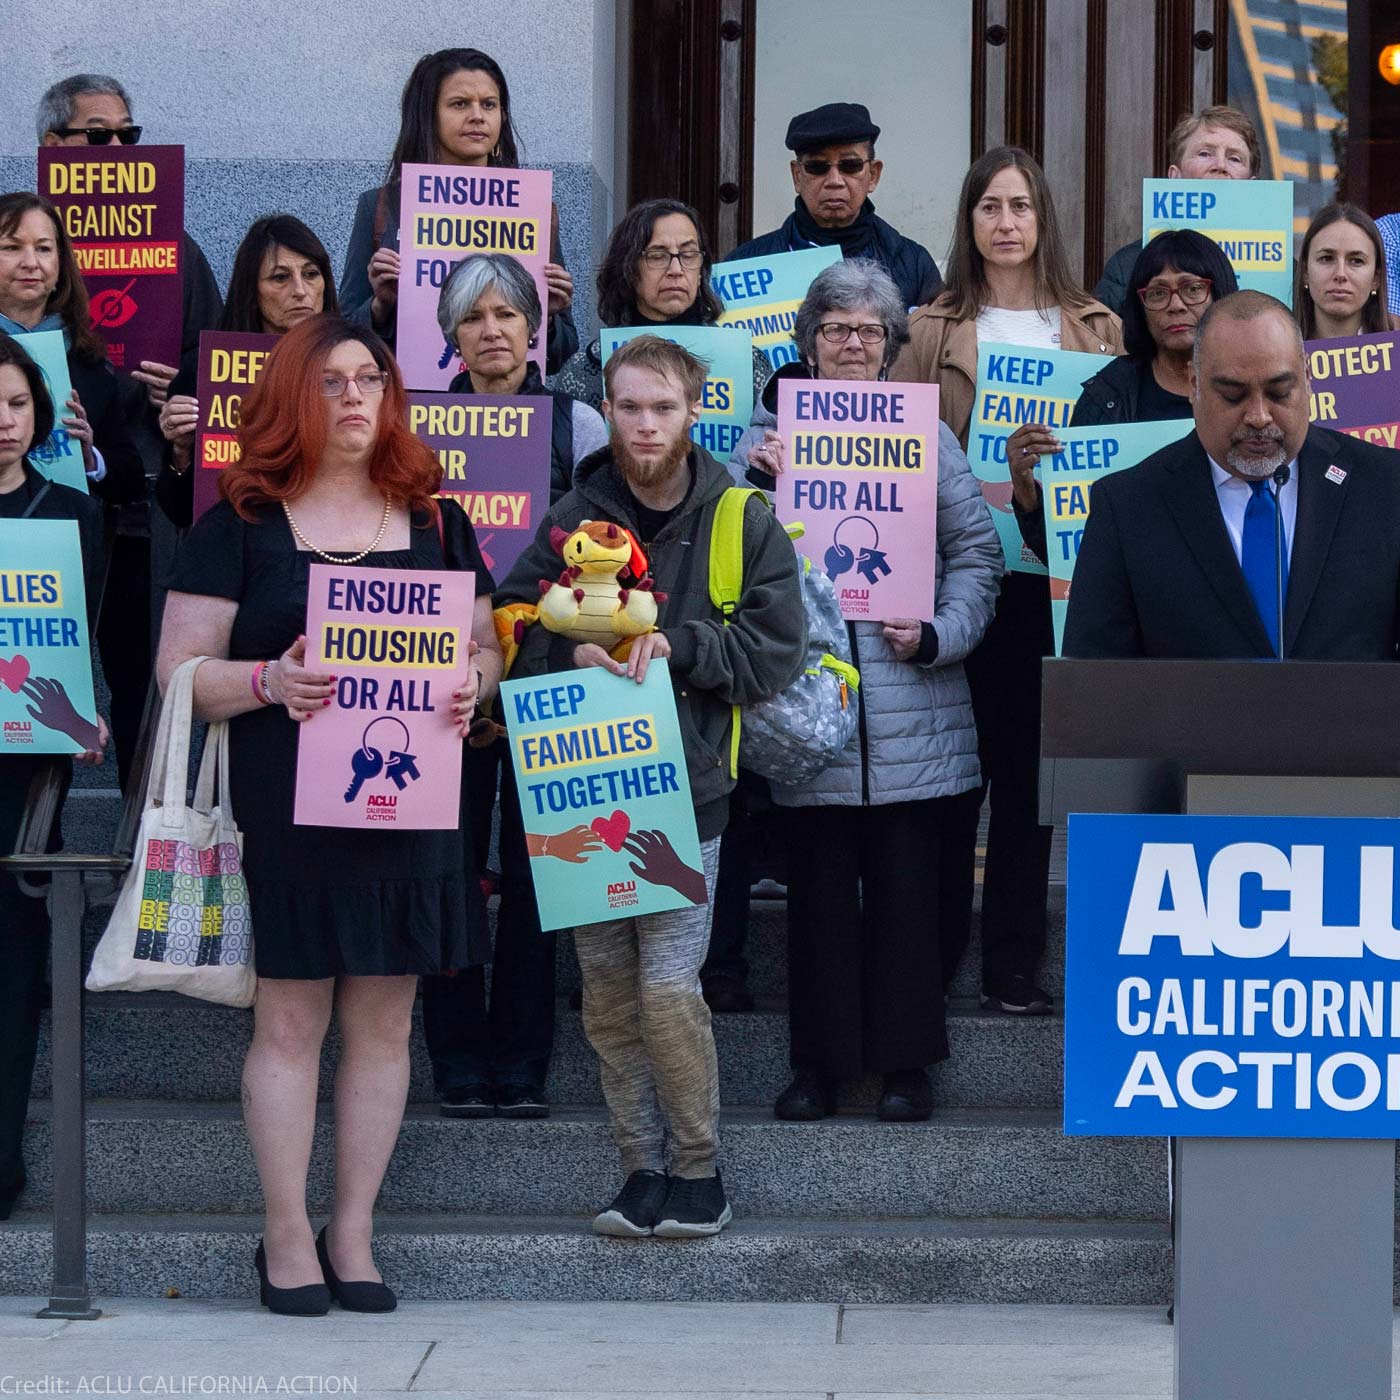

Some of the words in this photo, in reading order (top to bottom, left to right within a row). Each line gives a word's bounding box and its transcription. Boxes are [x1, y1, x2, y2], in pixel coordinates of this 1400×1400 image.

[50, 162, 156, 195] DEFEND
[418, 175, 520, 207] ENSURE
[1153, 191, 1216, 219] KEEP
[416, 217, 535, 251] HOUSING
[74, 247, 176, 270] RVEILLANCE
[1220, 241, 1283, 262] NITIES
[415, 259, 456, 288] FO
[712, 268, 774, 301] KEEP
[210, 349, 271, 384] DEF
[987, 354, 1054, 386] KEEP
[1306, 342, 1394, 380] OTECT
[410, 405, 534, 437] PROTECT
[796, 390, 905, 424] ENSURE
[982, 393, 1076, 429] FAMILI
[795, 435, 921, 469] HOUSING
[1052, 438, 1119, 472] KEEP
[794, 479, 847, 511] FOR
[854, 481, 904, 513] ALL
[1, 573, 59, 604] LIES
[328, 578, 442, 616] ENSURE
[840, 589, 869, 600] ACLU
[0, 617, 80, 647] ETHER
[324, 626, 455, 665] HOUSING
[335, 676, 379, 711] OR
[386, 679, 435, 712] ALL
[514, 683, 585, 724] KEEP
[3, 721, 33, 732] ACLU
[522, 718, 653, 770] FAMILIES
[367, 795, 397, 807] ACLU
[528, 762, 680, 815] TOGETHER
[607, 880, 637, 895] ACLU
[609, 898, 639, 909] ACTION
